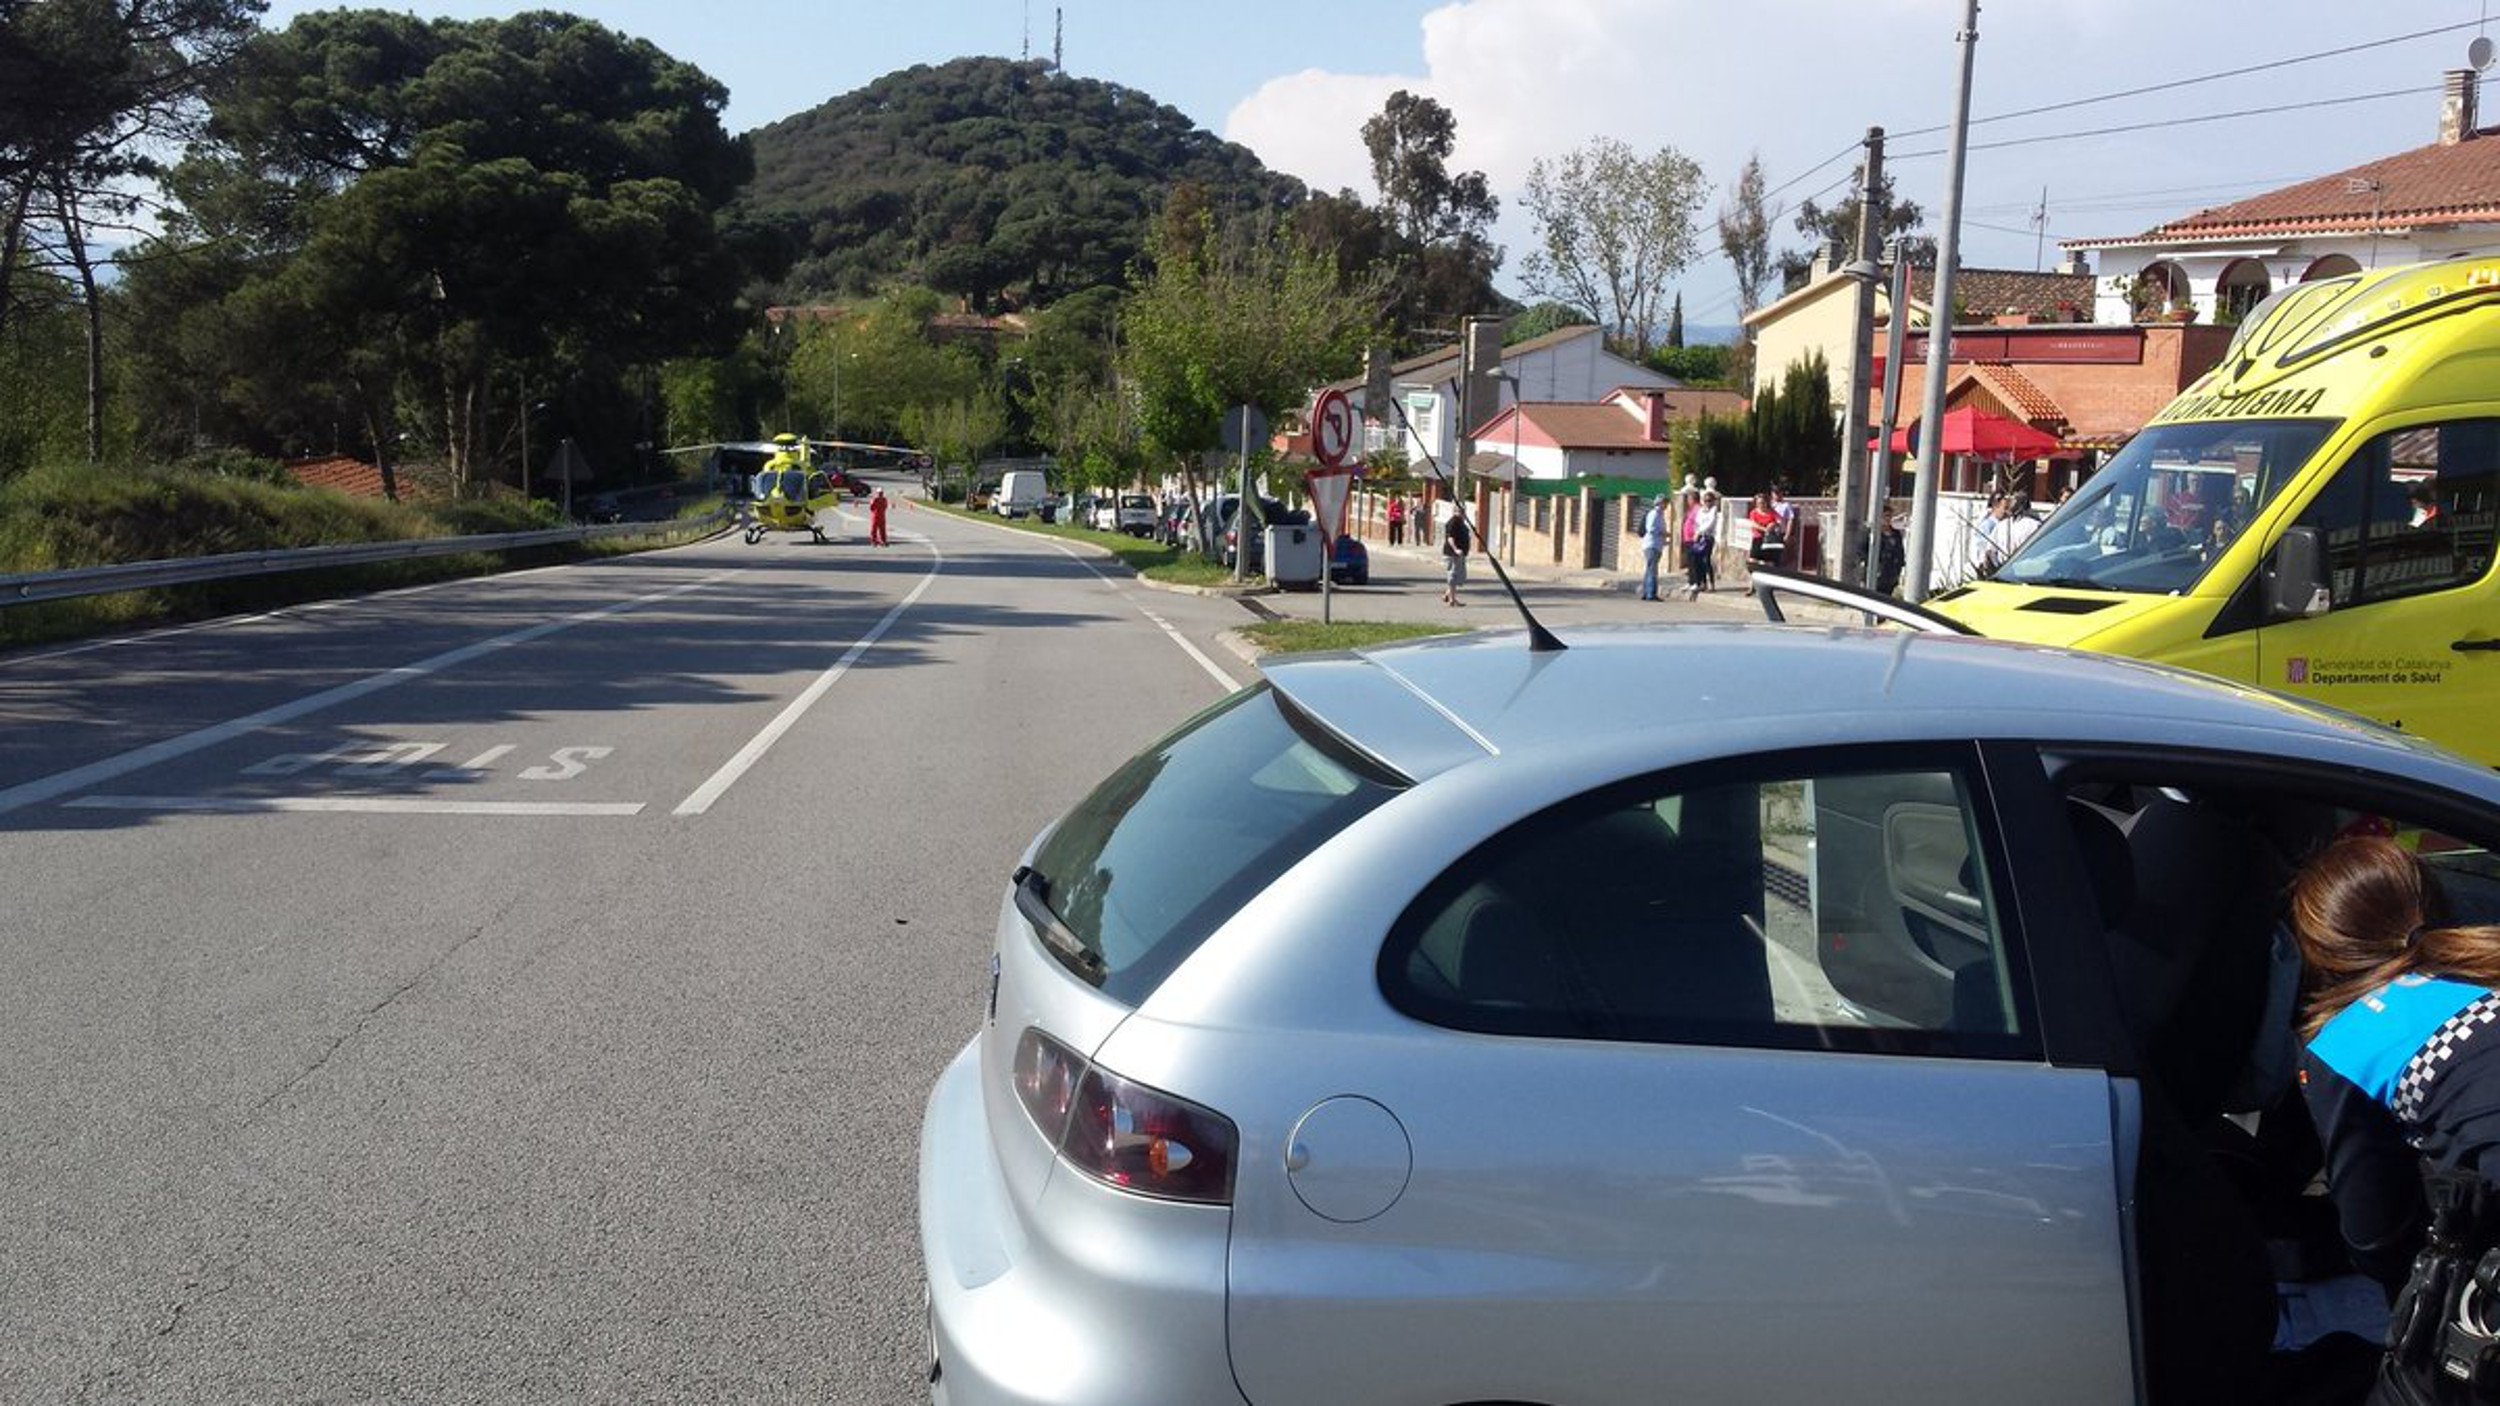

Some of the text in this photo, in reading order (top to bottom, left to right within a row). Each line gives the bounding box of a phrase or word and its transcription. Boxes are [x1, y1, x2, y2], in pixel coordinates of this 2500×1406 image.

[2312, 658, 2451, 671] Generalitat de Catalunya
[2312, 672, 2441, 686] Departament de Salut
